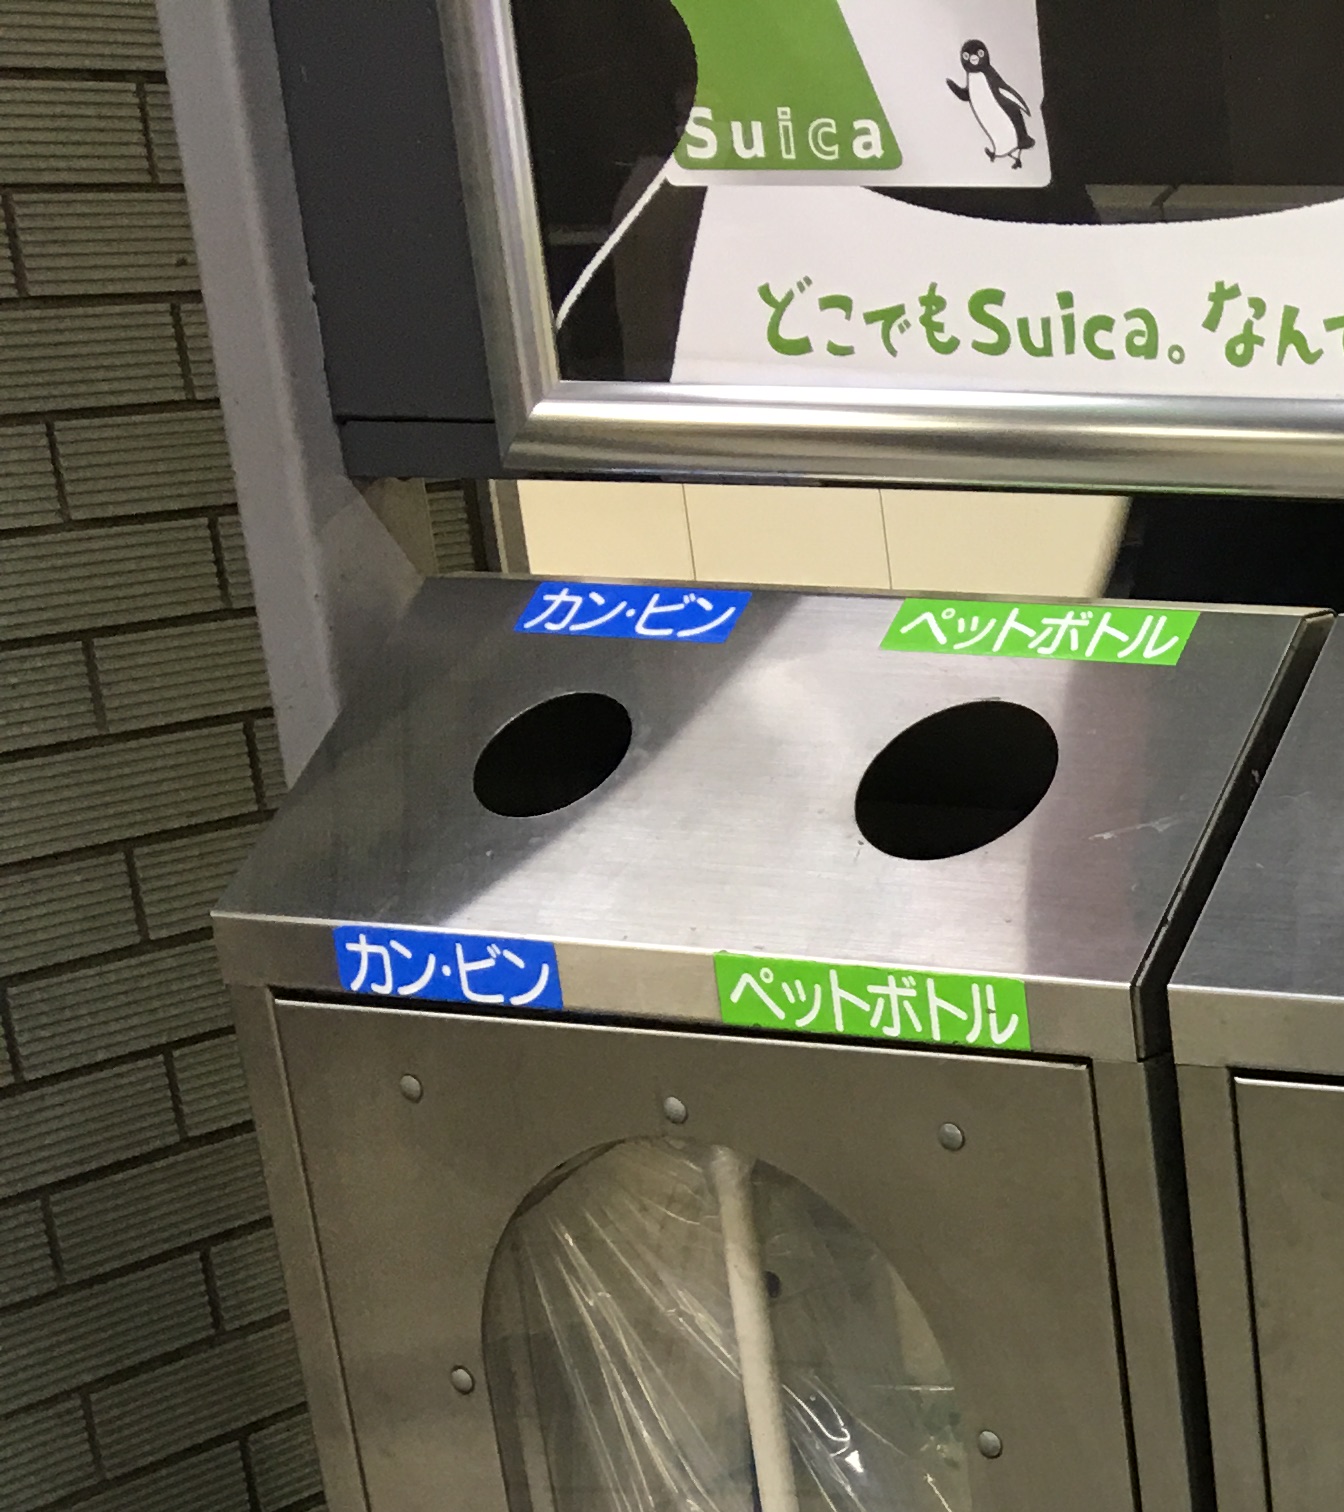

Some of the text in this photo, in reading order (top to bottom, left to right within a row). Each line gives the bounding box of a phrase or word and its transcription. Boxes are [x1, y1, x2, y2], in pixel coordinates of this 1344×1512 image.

[685, 106, 885, 161] Suica
[523, 587, 736, 634] カン・ビン
[900, 608, 1179, 658] ペットボトル
[347, 934, 550, 1004] カン・ビン
[731, 968, 1020, 1044] ペットボトル
